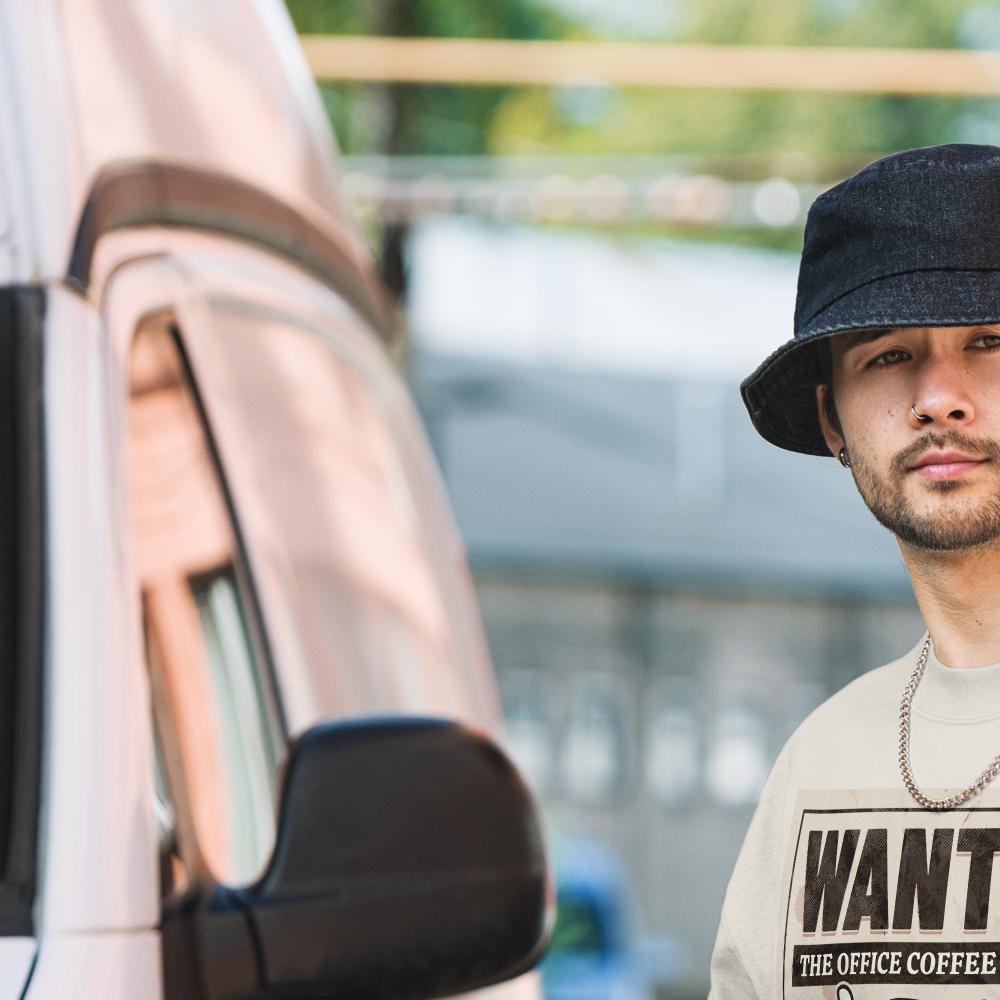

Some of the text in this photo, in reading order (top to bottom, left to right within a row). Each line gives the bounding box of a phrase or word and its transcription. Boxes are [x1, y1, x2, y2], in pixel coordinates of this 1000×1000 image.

[800, 952, 833, 977] THE
[837, 951, 902, 976] OFFICE
[907, 951, 996, 975] COFFEE
